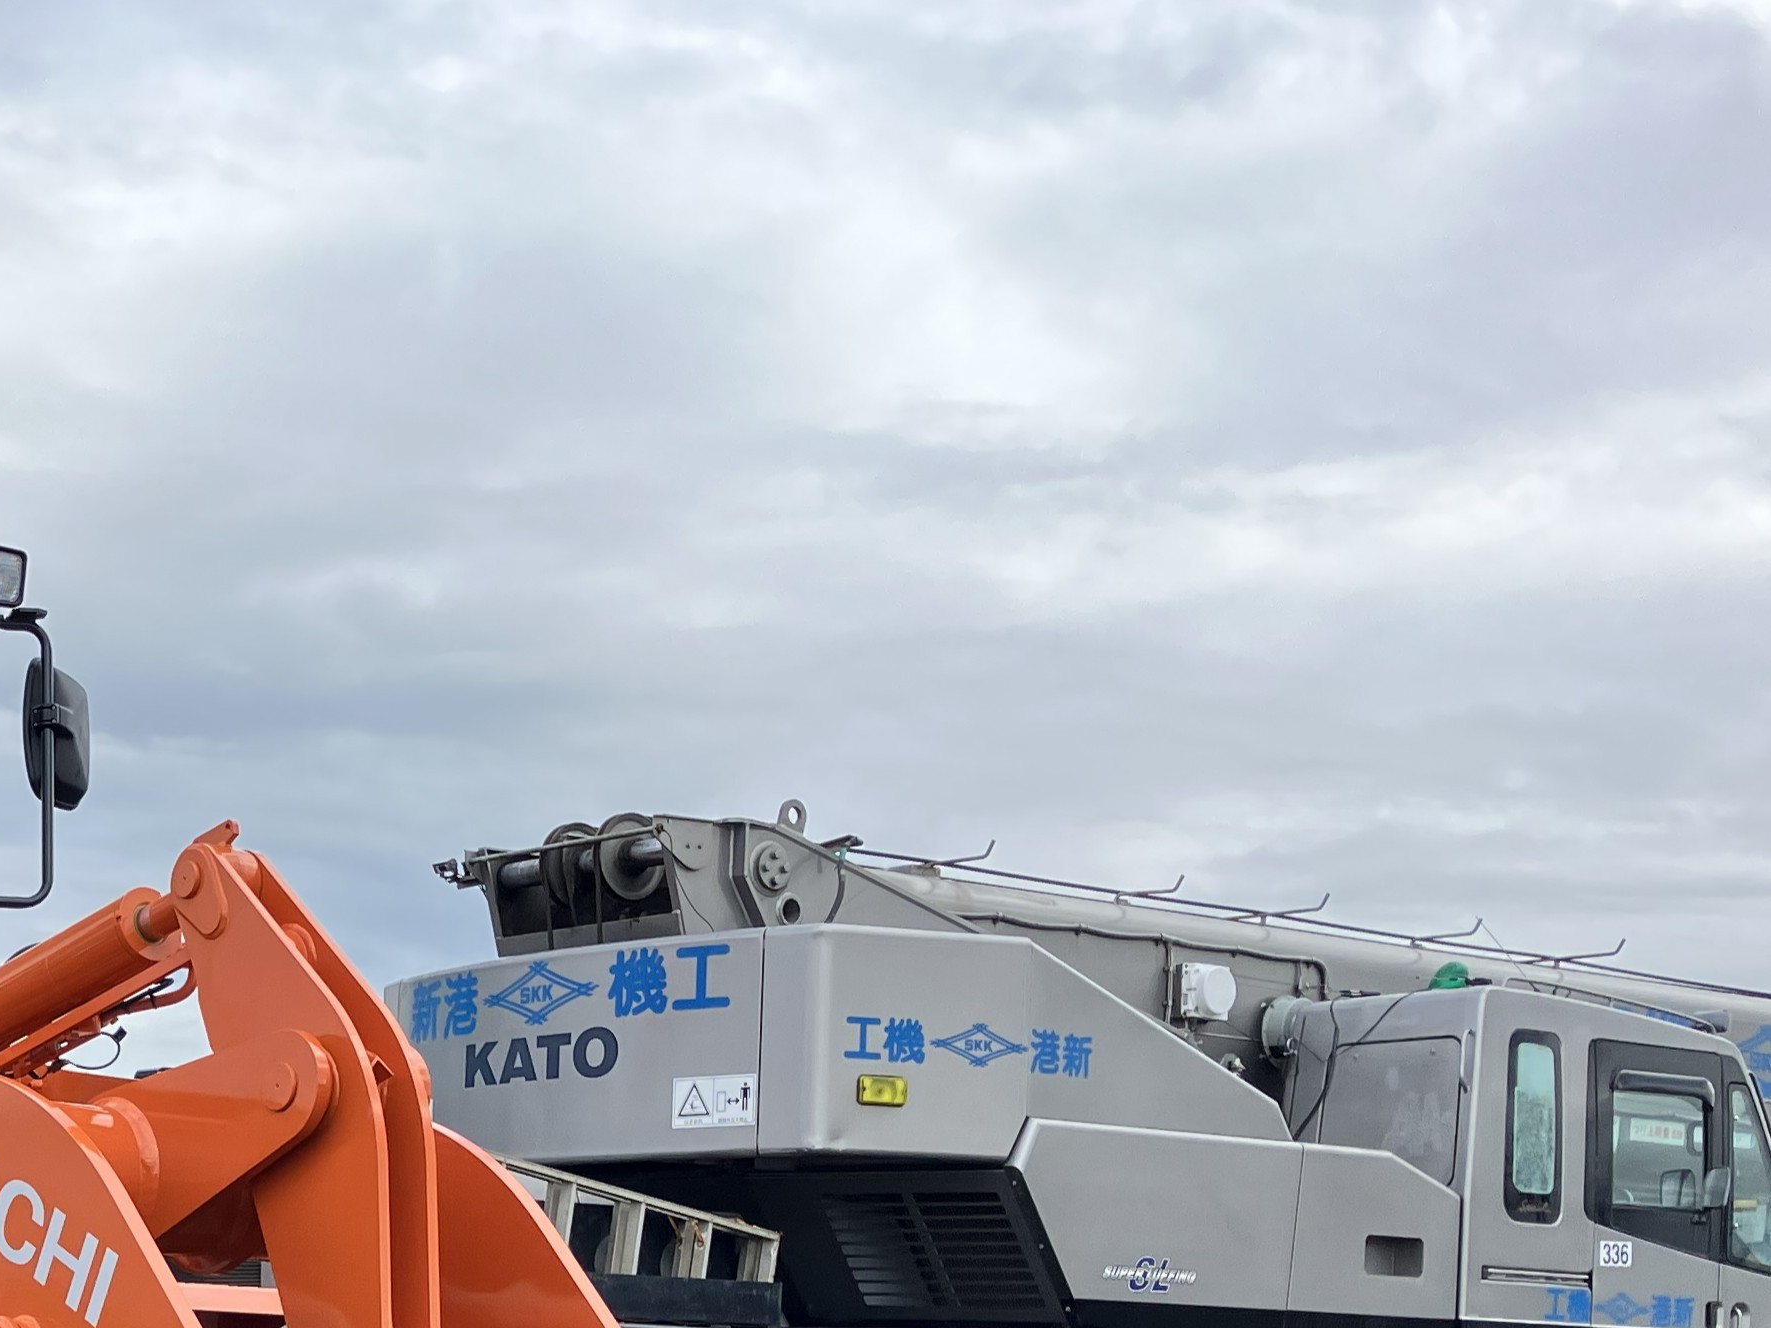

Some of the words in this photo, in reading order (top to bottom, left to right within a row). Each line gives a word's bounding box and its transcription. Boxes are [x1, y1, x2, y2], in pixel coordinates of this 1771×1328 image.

[411, 970, 478, 1043] 新港
[520, 984, 553, 1005] SKK
[608, 944, 731, 1018] 機工
[464, 1026, 619, 1088] KATO
[843, 1016, 925, 1064] 工機
[964, 1039, 993, 1052] SKK
[1602, 1243, 1629, 1265] 336
